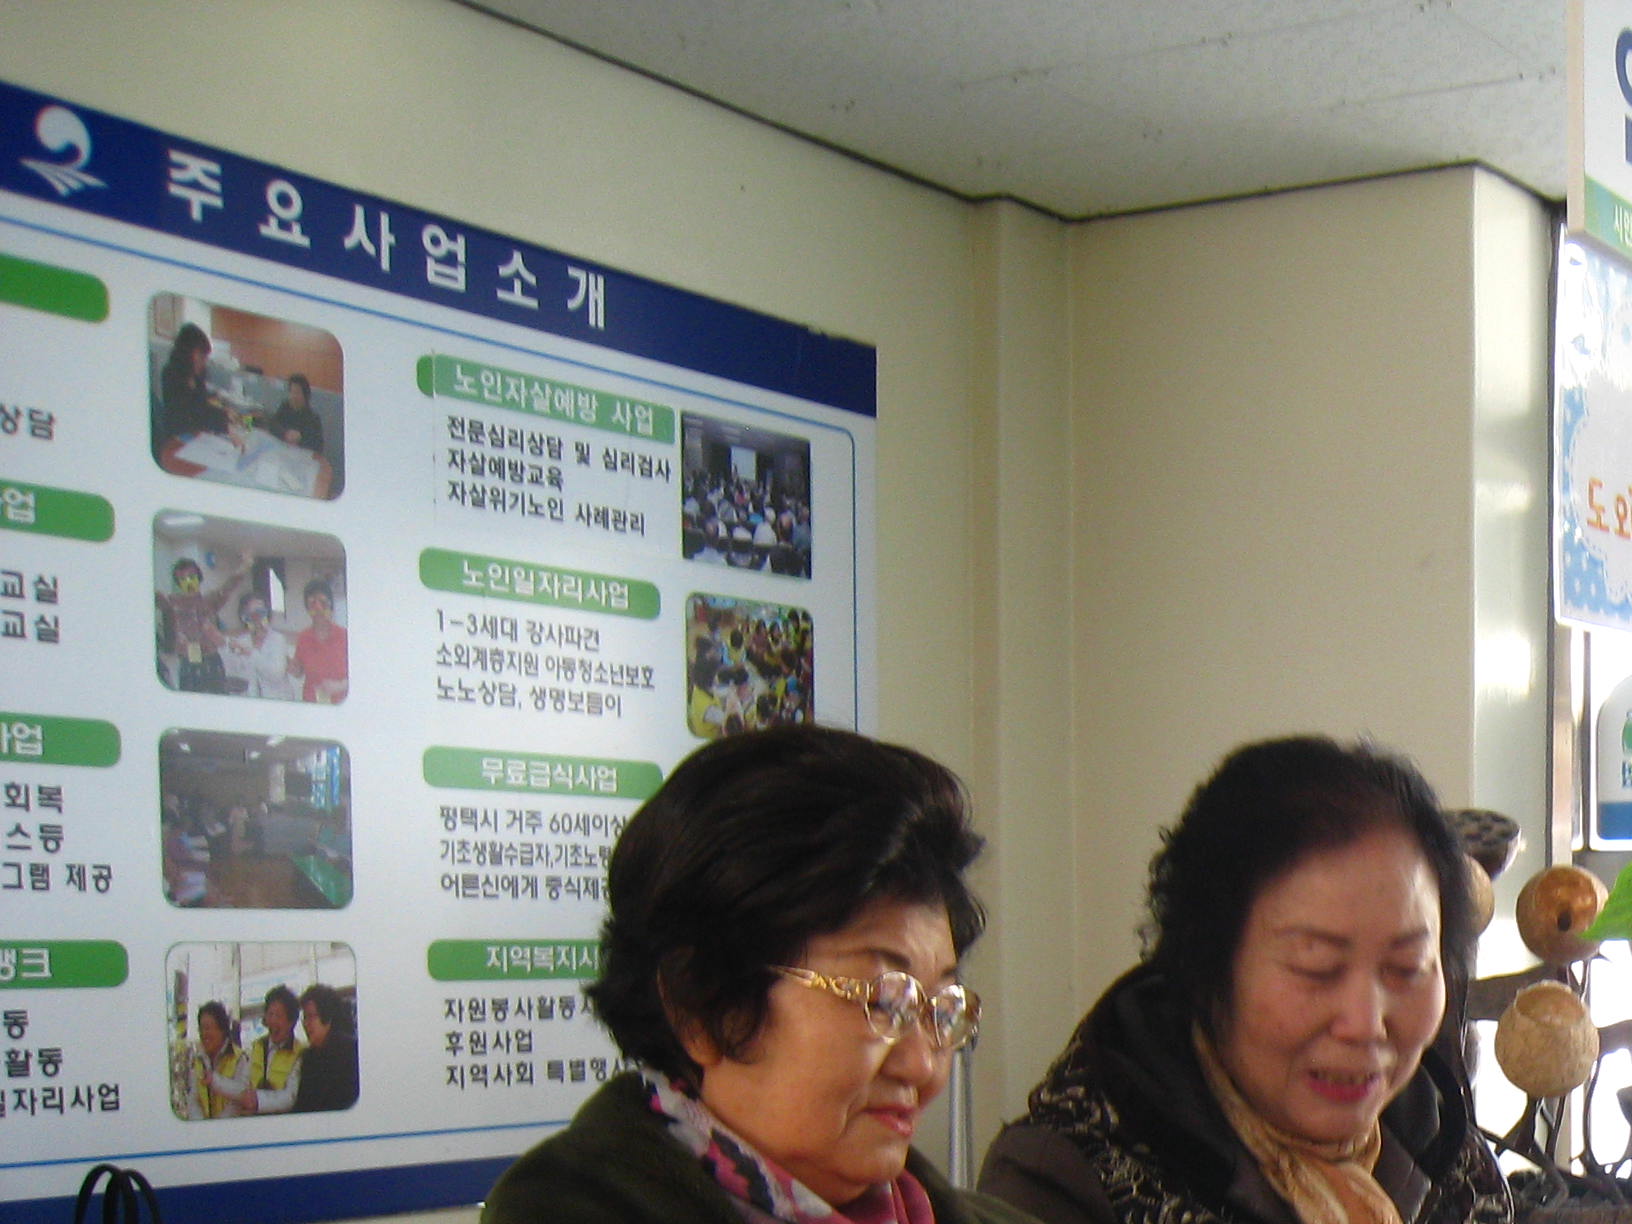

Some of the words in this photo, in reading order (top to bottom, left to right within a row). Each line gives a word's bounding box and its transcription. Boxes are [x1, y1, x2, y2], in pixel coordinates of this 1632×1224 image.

[454, 364, 600, 423] 노인자살예방
[611, 401, 654, 435] 사업
[447, 415, 564, 461] 전문심리상담
[574, 441, 591, 467] 및
[602, 447, 672, 483] 심리검사
[447, 447, 564, 492] 자살예방교육
[447, 480, 565, 522] 자살위기노인
[575, 502, 646, 536] 사례관리
[462, 558, 630, 611] 노인일자리사업
[436, 608, 519, 642] 1-3세대
[525, 620, 600, 652] 강사파견
[436, 641, 540, 678] 소외계층지원
[545, 655, 656, 690] 아동청소년보호
[481, 757, 618, 793] 무료급식사업
[4, 781, 64, 815] 회복
[440, 805, 499, 834] 평택시
[506, 809, 544, 835] 거주
[66, 863, 113, 894] 제공
[445, 1028, 534, 1057] 후원사업
[6, 1047, 64, 1078] 활동
[446, 1060, 535, 1091] 지역사회
[0, 1083, 121, 1118] 자리사업
